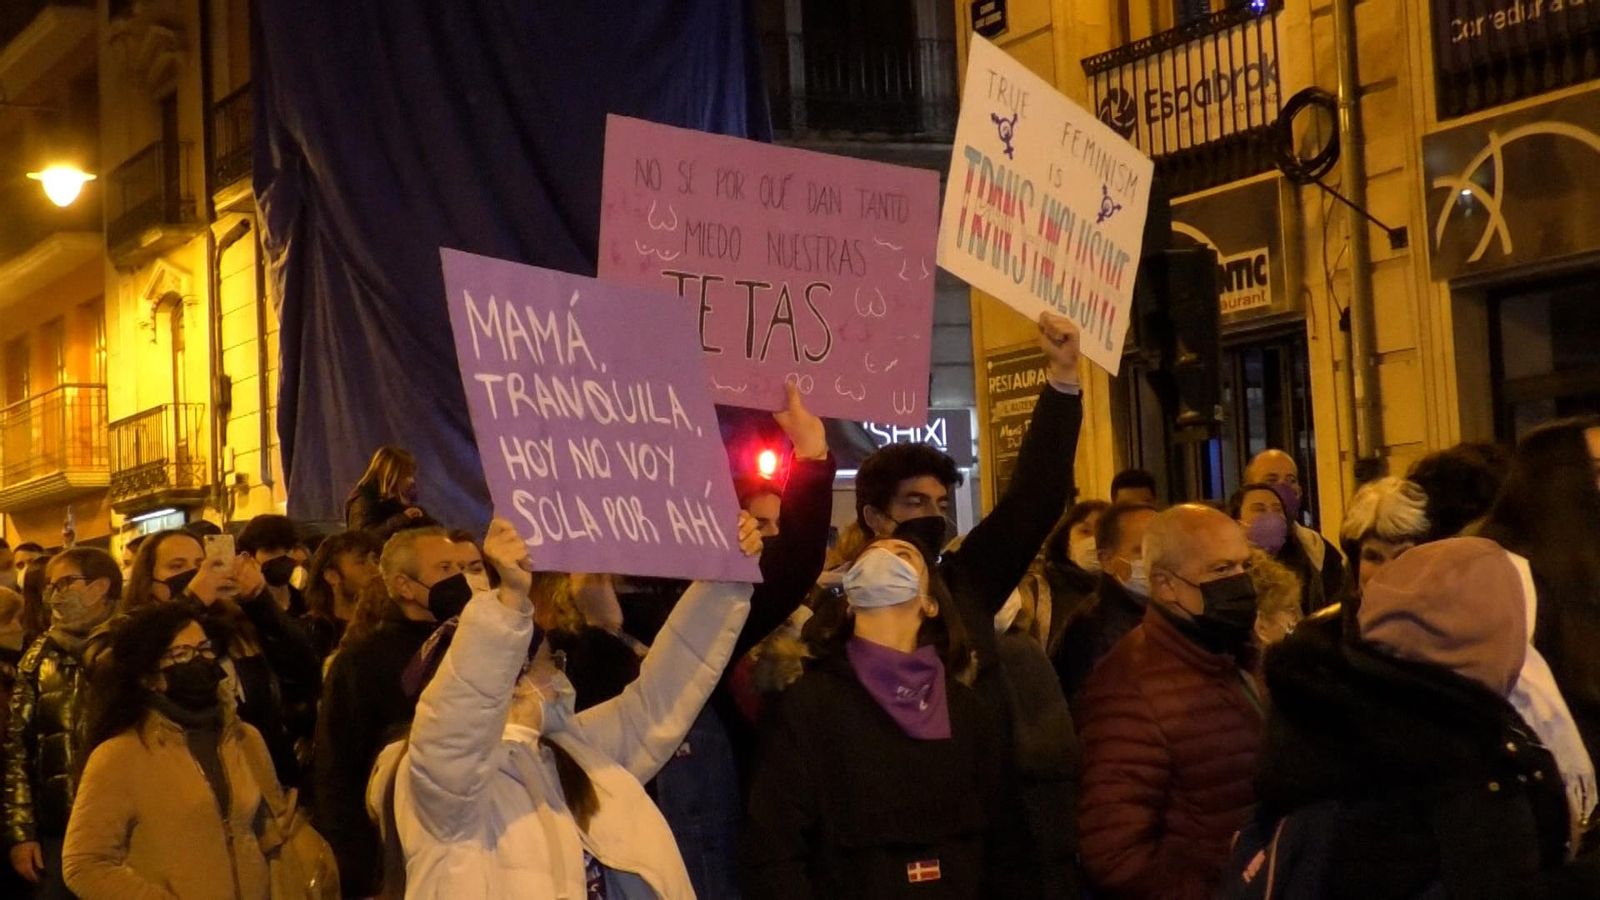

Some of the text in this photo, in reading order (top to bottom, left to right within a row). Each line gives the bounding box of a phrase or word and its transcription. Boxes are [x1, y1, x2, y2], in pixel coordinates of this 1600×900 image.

[986, 69, 1030, 119] TRUE
[1145, 52, 1279, 124] Espabrok
[633, 158, 662, 191] NO
[677, 159, 696, 194] SE
[715, 166, 745, 200] POR
[807, 181, 843, 216] DAN
[855, 187, 910, 225] TANTO
[1050, 163, 1064, 189] IS
[1061, 121, 1139, 204] FEMINISM
[957, 144, 1035, 285] TRANS
[684, 219, 867, 278] MIEDO NUESTRAS
[1218, 253, 1268, 293] NTIC
[1221, 290, 1267, 309] aurant
[474, 373, 703, 438] TRANQUILA,
[988, 367, 1049, 394] RESTAURA
[499, 435, 676, 488] HOY NO VOY
[511, 480, 730, 551] SOLA POR AHÍ
